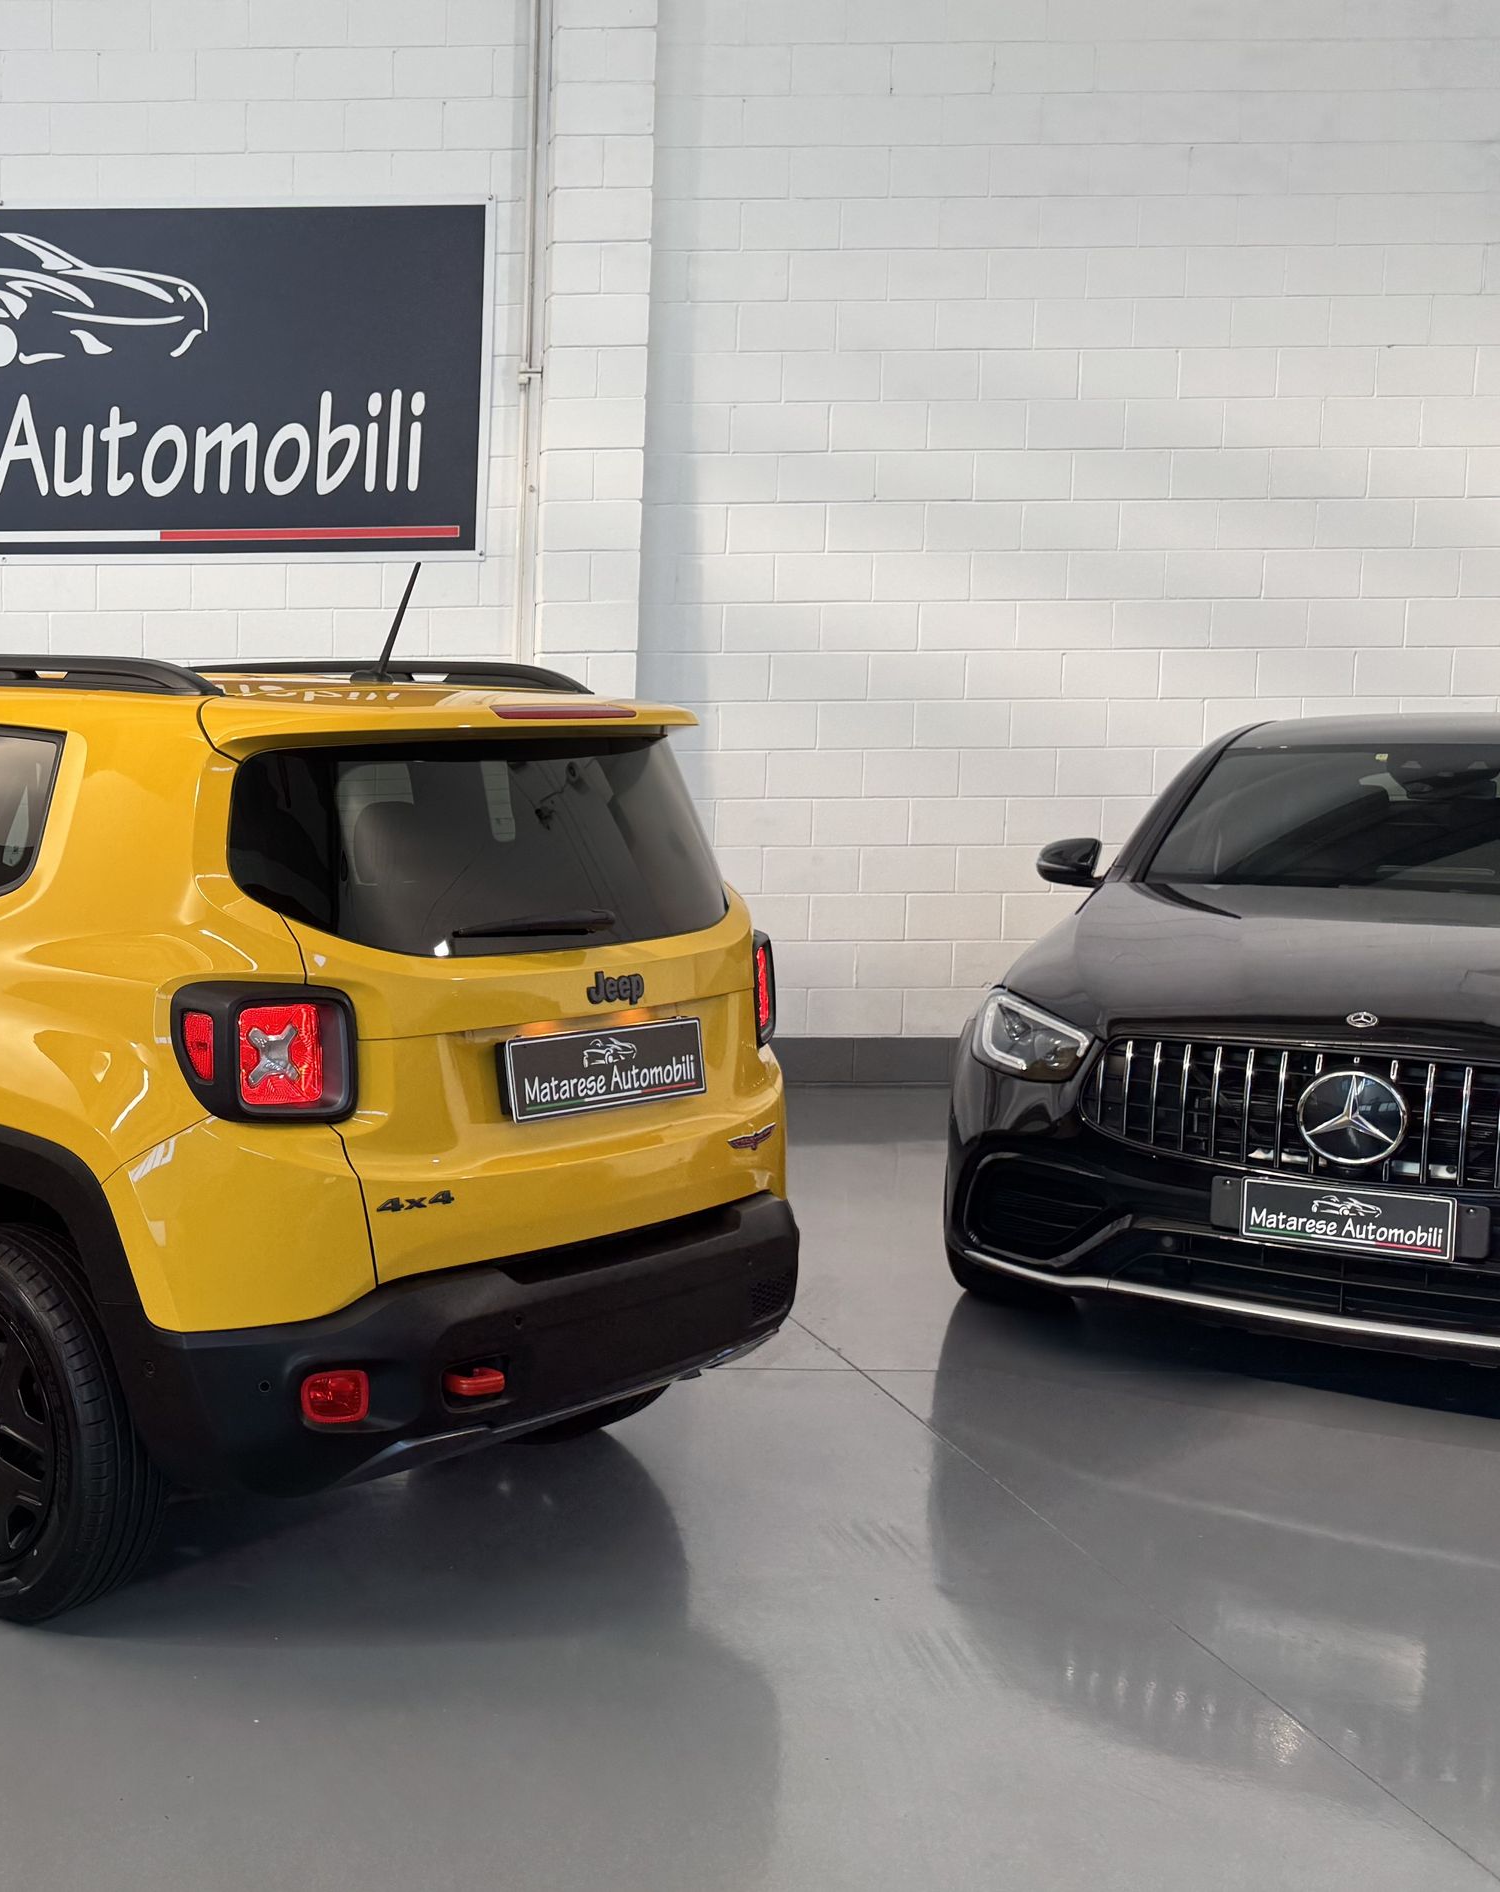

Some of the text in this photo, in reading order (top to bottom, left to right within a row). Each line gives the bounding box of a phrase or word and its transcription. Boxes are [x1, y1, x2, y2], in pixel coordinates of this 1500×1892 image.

[587, 971, 644, 1005] Jeep
[524, 1054, 695, 1104] Matarese Automobili
[376, 1190, 455, 1212] 4x4
[1250, 1207, 1444, 1248] Matarese Automobili
